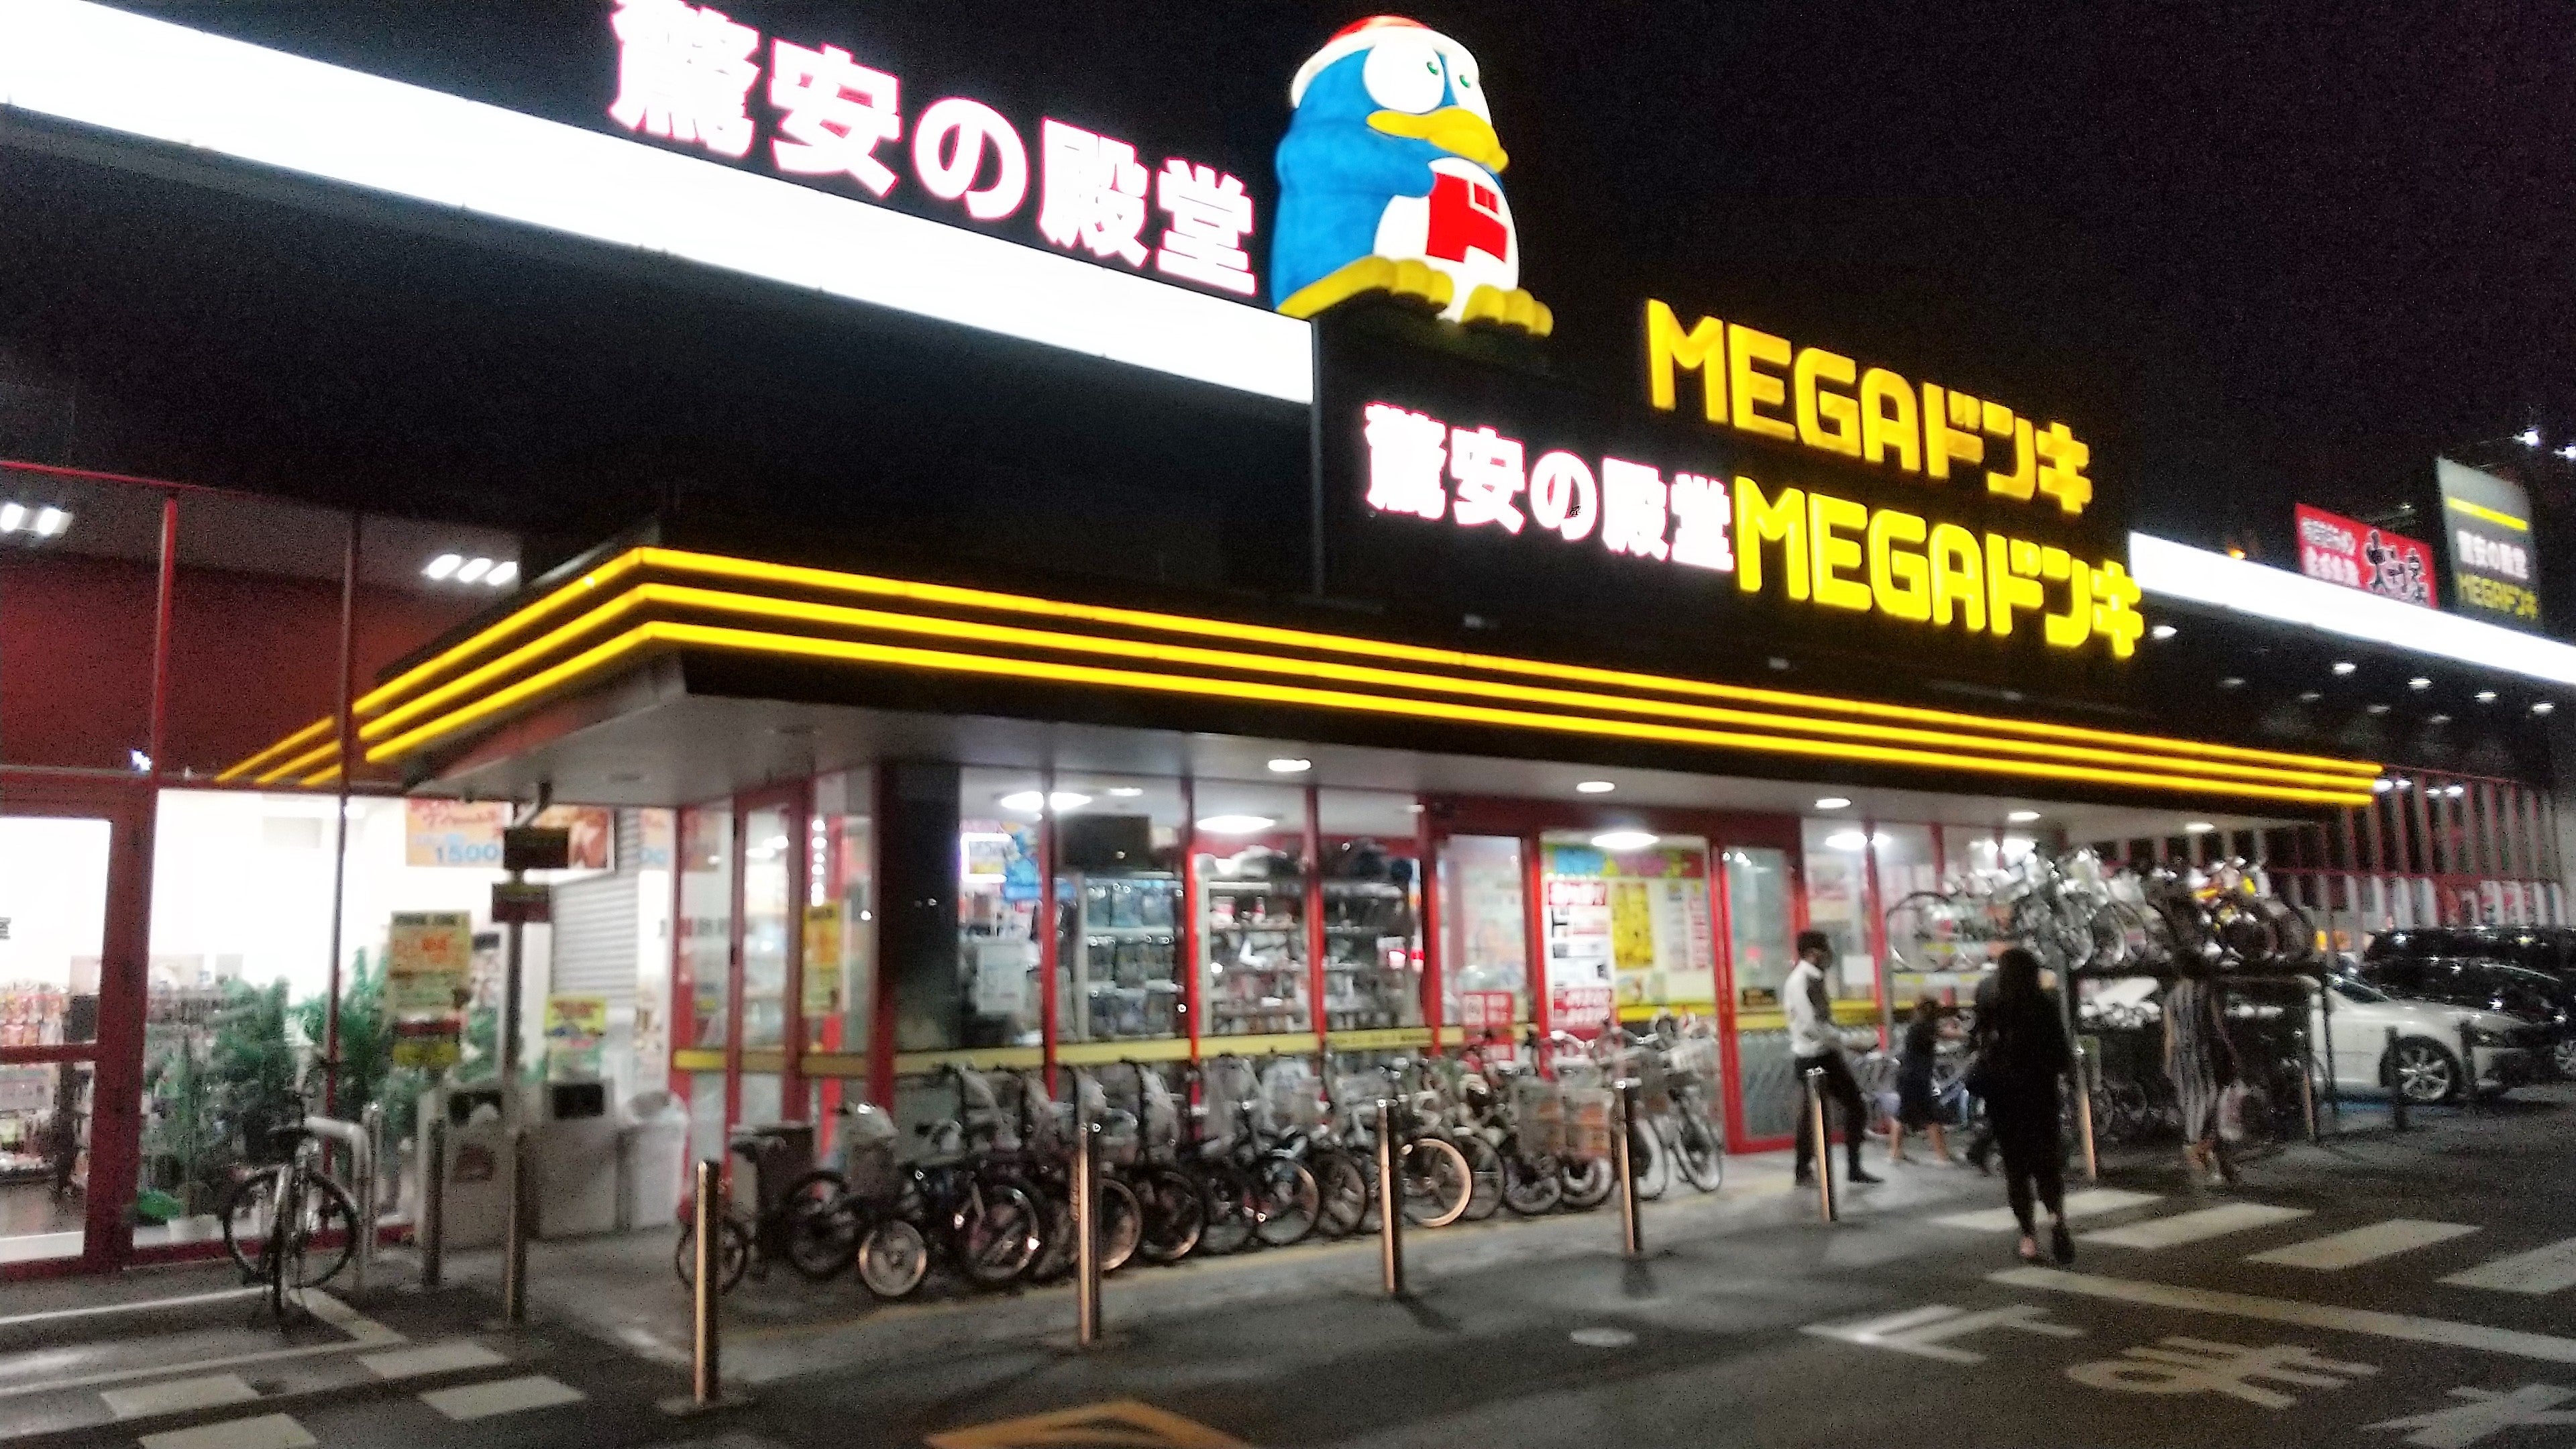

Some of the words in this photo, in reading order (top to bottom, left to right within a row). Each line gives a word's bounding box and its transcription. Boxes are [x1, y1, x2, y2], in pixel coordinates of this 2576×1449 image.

[608, 0, 1257, 298] 驚安の殿堂
[1364, 401, 1736, 572] 驚安の殿堂
[1734, 475, 2145, 659] MEGAドンキ
[1645, 298, 2093, 514] MEGAドンキ
